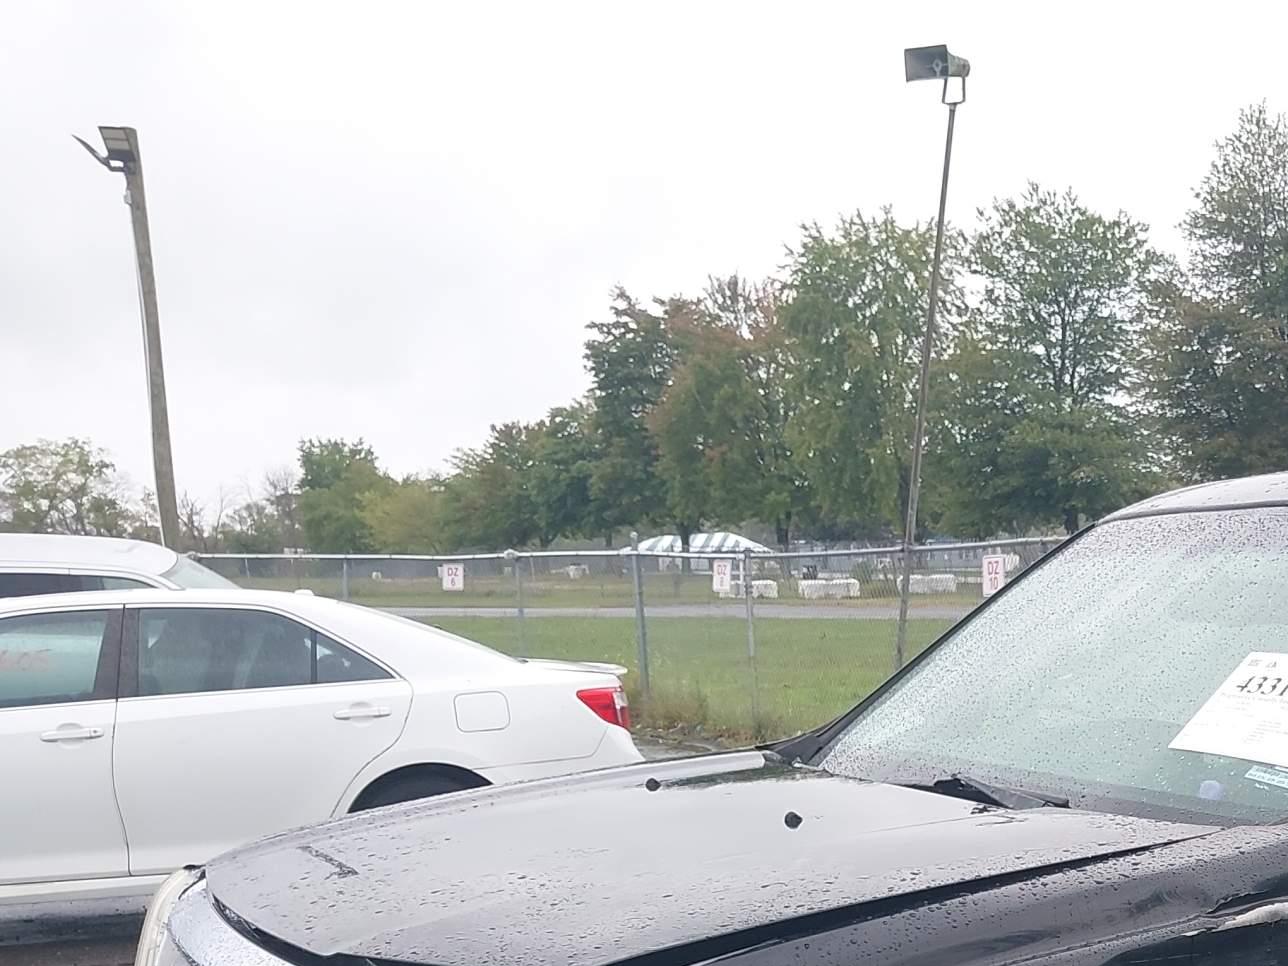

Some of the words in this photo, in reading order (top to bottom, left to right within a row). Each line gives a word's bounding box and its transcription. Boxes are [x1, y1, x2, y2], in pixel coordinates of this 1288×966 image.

[447, 567, 459, 577] DZ
[987, 561, 1000, 575] DZ
[989, 576, 999, 590] 10
